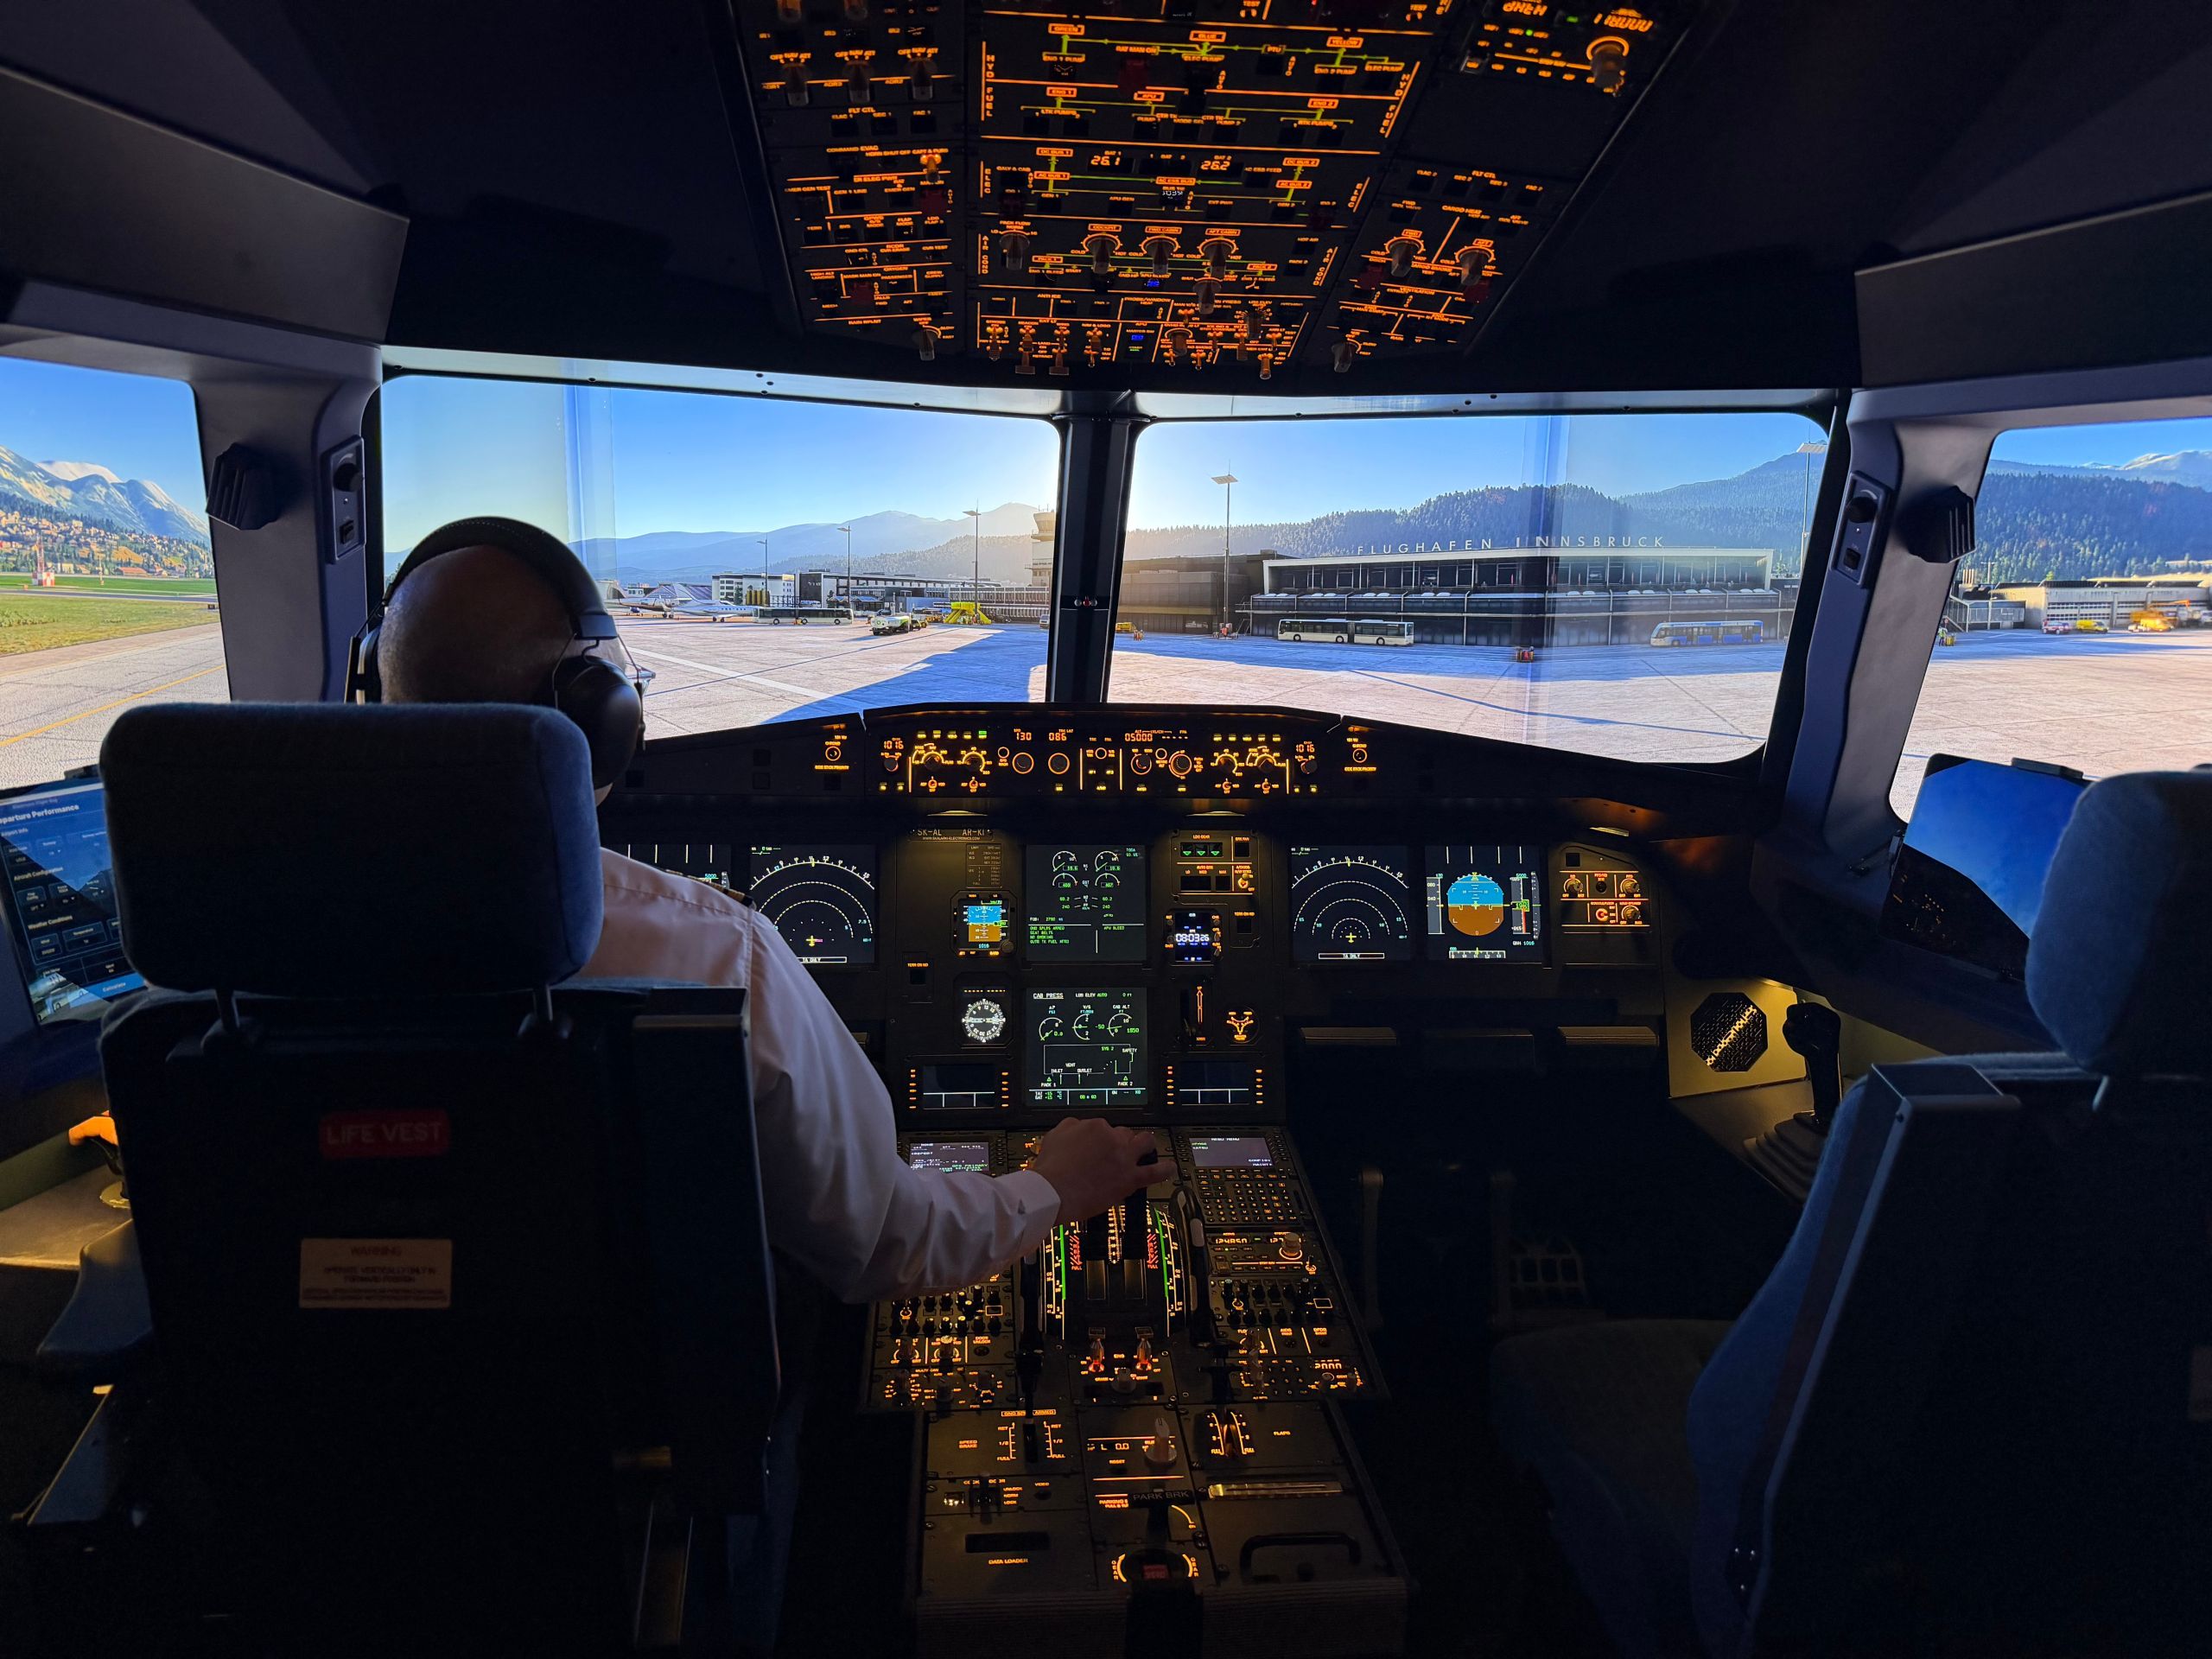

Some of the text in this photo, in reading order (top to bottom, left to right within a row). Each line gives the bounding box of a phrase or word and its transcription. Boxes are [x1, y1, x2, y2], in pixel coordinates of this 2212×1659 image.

[986, 54, 995, 79] HYD
[1395, 73, 1410, 97] HYD
[986, 86, 995, 117] FUEL
[1378, 105, 1397, 134] FUEL
[1442, 205, 1465, 213] CARGO
[1357, 536, 1664, 556] FLUGHAFEN INNSBRUCK
[883, 741, 904, 749] 1016
[1125, 733, 1153, 741] 05000
[1296, 744, 1315, 753] 1016
[0, 804, 79, 824] parture Performance
[327, 1122, 442, 1145] LIFE VEST
